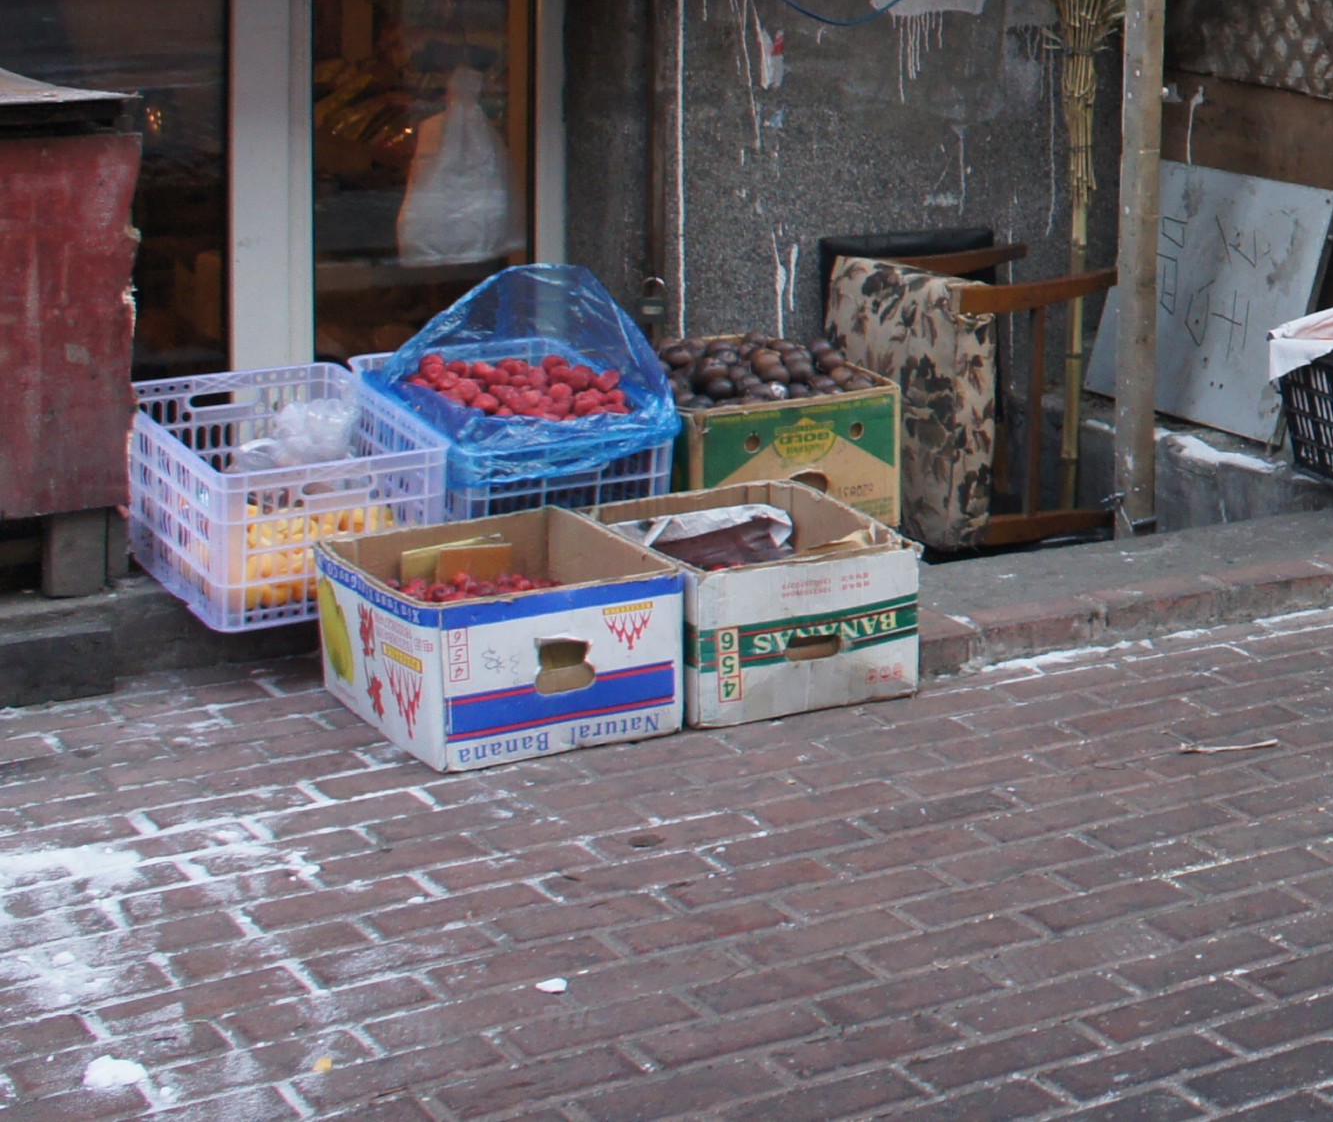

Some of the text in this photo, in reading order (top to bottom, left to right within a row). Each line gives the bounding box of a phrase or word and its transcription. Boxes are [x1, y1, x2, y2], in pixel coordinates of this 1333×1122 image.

[452, 630, 463, 645] 6
[720, 631, 734, 651] 6
[453, 648, 463, 662] 5
[454, 664, 464, 679] 4
[722, 655, 735, 675] 5
[723, 680, 737, 698] 4
[457, 712, 660, 764] Natural Banana
